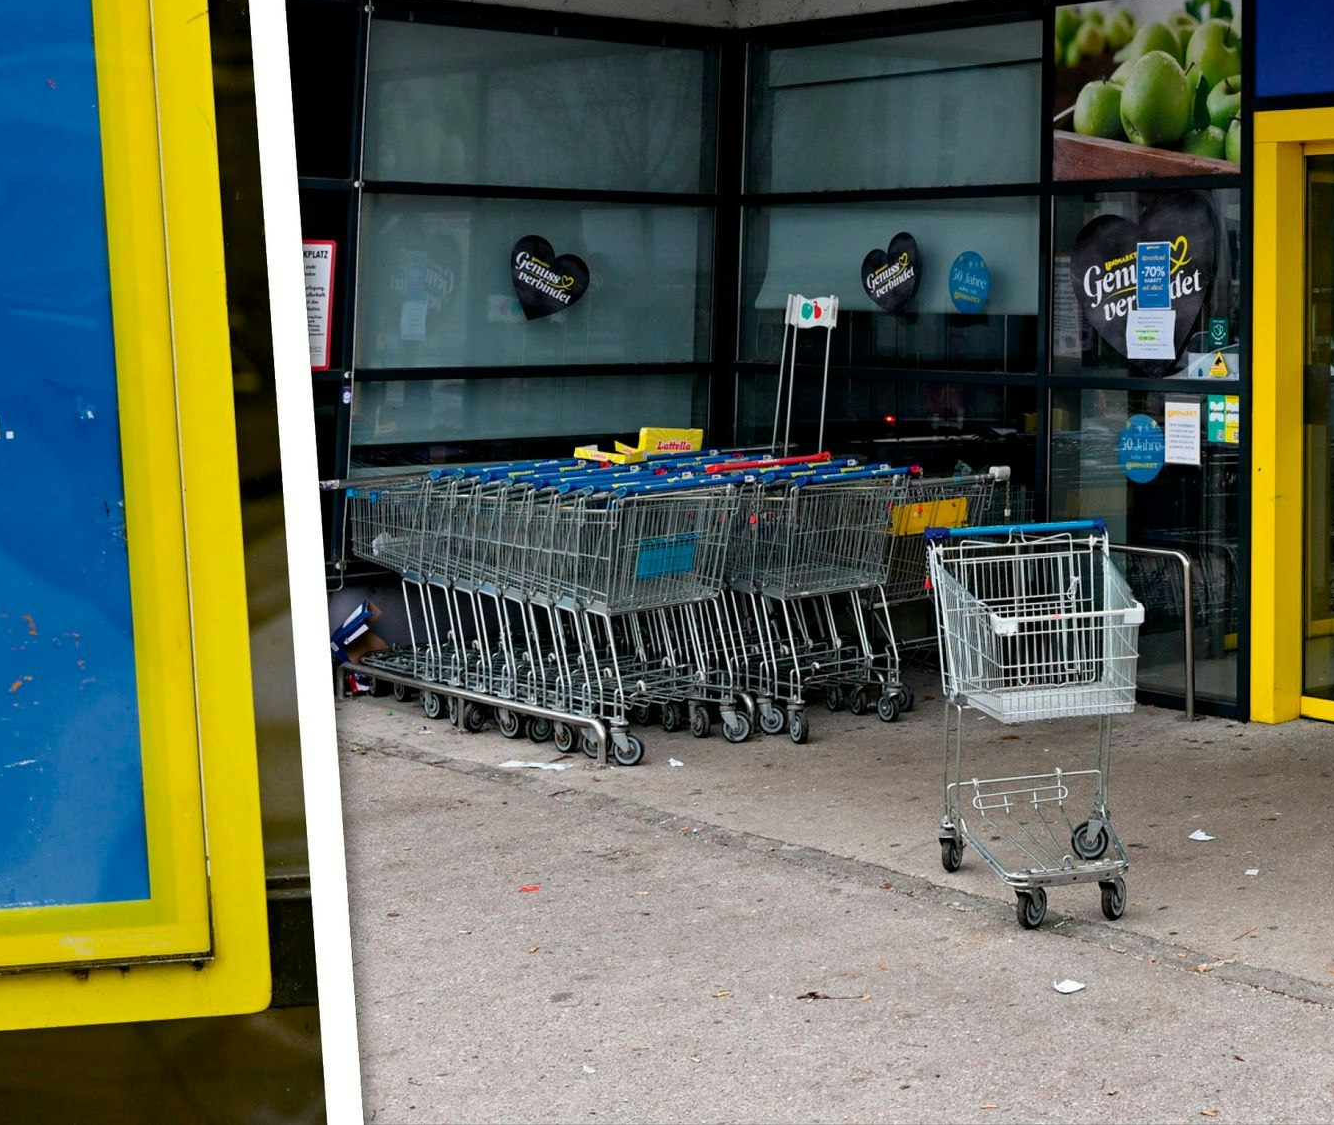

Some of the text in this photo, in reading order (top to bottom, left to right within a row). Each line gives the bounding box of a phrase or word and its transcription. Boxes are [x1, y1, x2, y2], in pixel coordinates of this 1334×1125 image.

[515, 251, 561, 285] Genuss
[866, 261, 900, 293] Genuss
[875, 265, 915, 298] verbindet
[1141, 266, 1166, 277] -70%
[518, 271, 572, 304] verbindet
[1083, 265, 1137, 308] Genu
